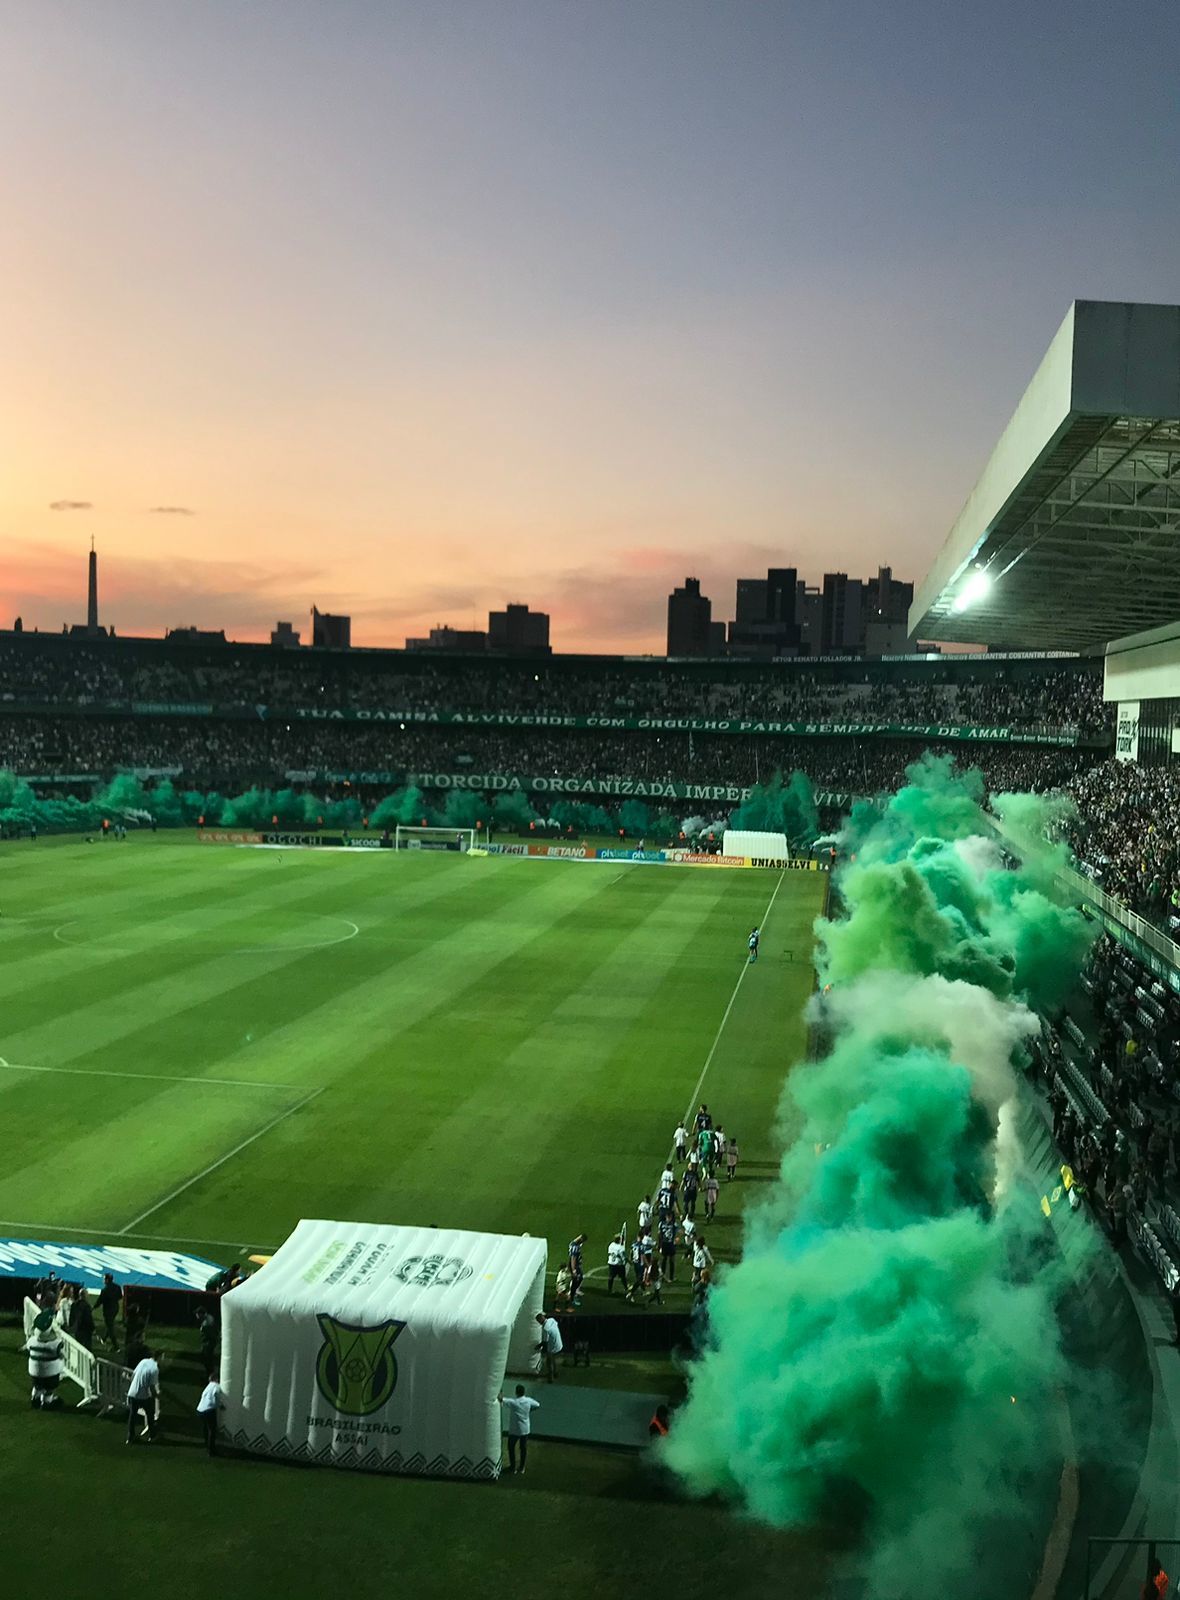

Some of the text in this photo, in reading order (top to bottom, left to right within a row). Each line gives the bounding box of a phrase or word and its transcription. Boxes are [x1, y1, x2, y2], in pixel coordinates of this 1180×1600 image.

[451, 712, 576, 726] ALVIVERDE
[587, 718, 625, 727] COM
[638, 720, 729, 730] ORGULHO
[740, 722, 796, 732] PARA
[937, 727, 961, 737] DE
[967, 728, 1008, 738] AMAR
[1118, 720, 1131, 735] PRO
[418, 773, 521, 790] TORCIDA
[531, 777, 677, 798] ORGANIZADA
[547, 847, 587, 858] BETANO
[683, 853, 744, 866] Mercado Bitcoin
[751, 857, 811, 870] UNIASSELVI
